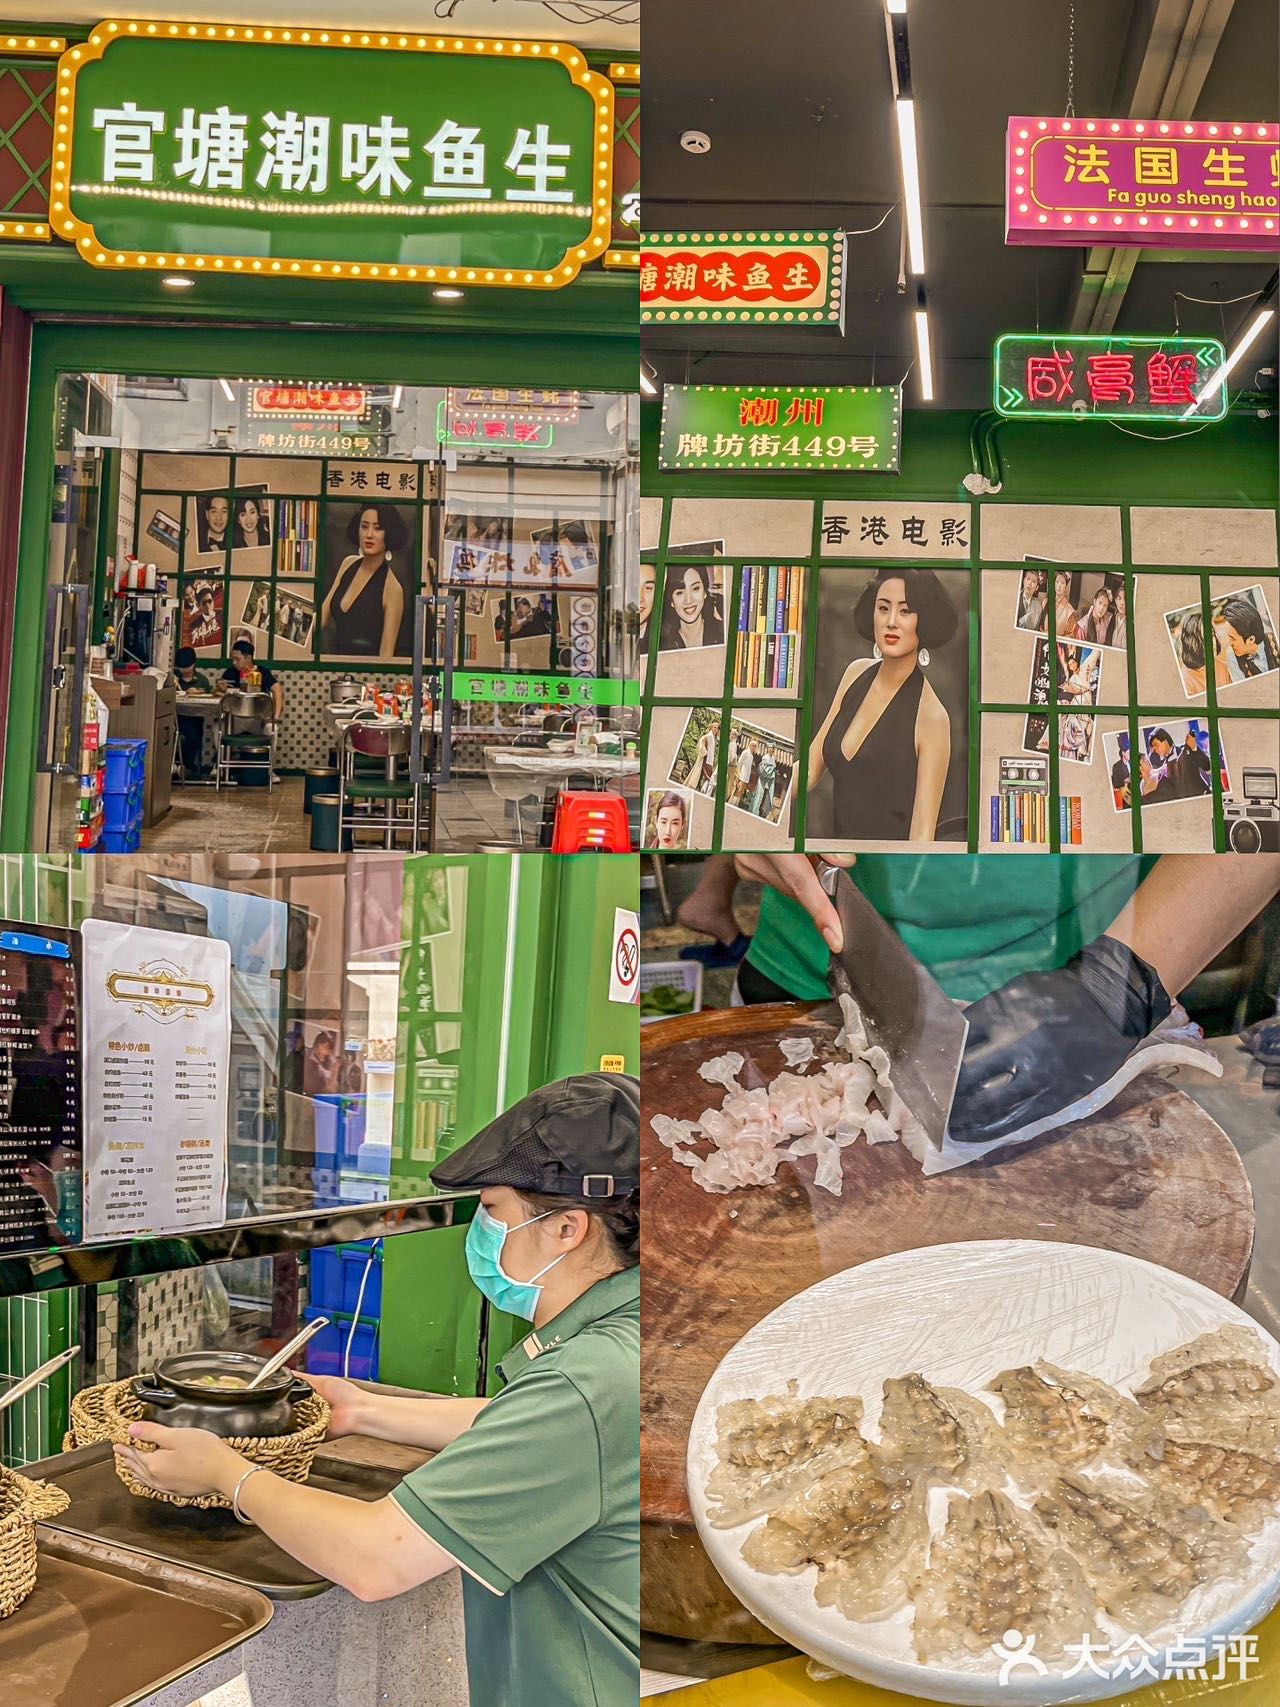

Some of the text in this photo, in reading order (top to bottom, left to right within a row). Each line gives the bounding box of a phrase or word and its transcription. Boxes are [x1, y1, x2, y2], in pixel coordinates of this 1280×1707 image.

[92, 102, 574, 203] 官塘潮味鱼生
[1063, 143, 1280, 187] 法国生
[1107, 188, 1277, 209] Fa guo sheng hao
[738, 397, 824, 426] 潮州
[257, 433, 371, 450] 牌坊街449号
[675, 434, 880, 458] 牌坊街449号
[327, 470, 416, 491] 香港电影
[821, 515, 969, 547] 香港电影
